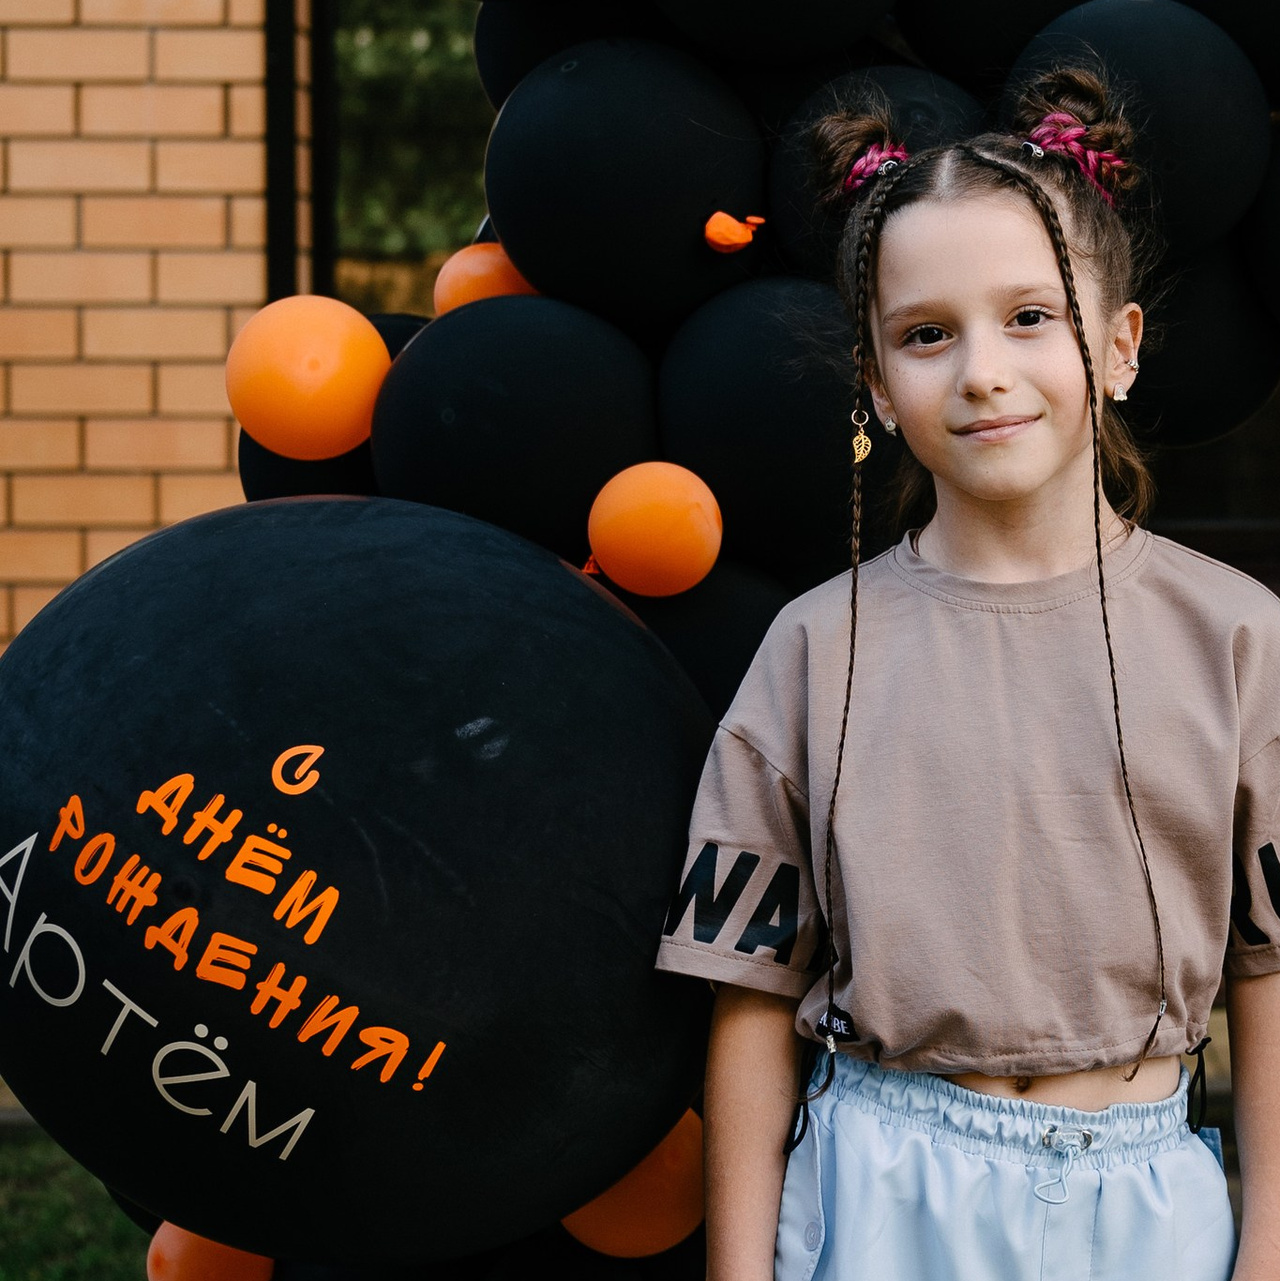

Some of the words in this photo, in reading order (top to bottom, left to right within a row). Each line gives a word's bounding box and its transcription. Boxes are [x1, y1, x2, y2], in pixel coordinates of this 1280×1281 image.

[271, 744, 325, 796] С
[135, 772, 340, 945] ДНЁМ
[663, 841, 838, 972] WA
[48, 794, 447, 1092] РОЖДЕНИЯ!
